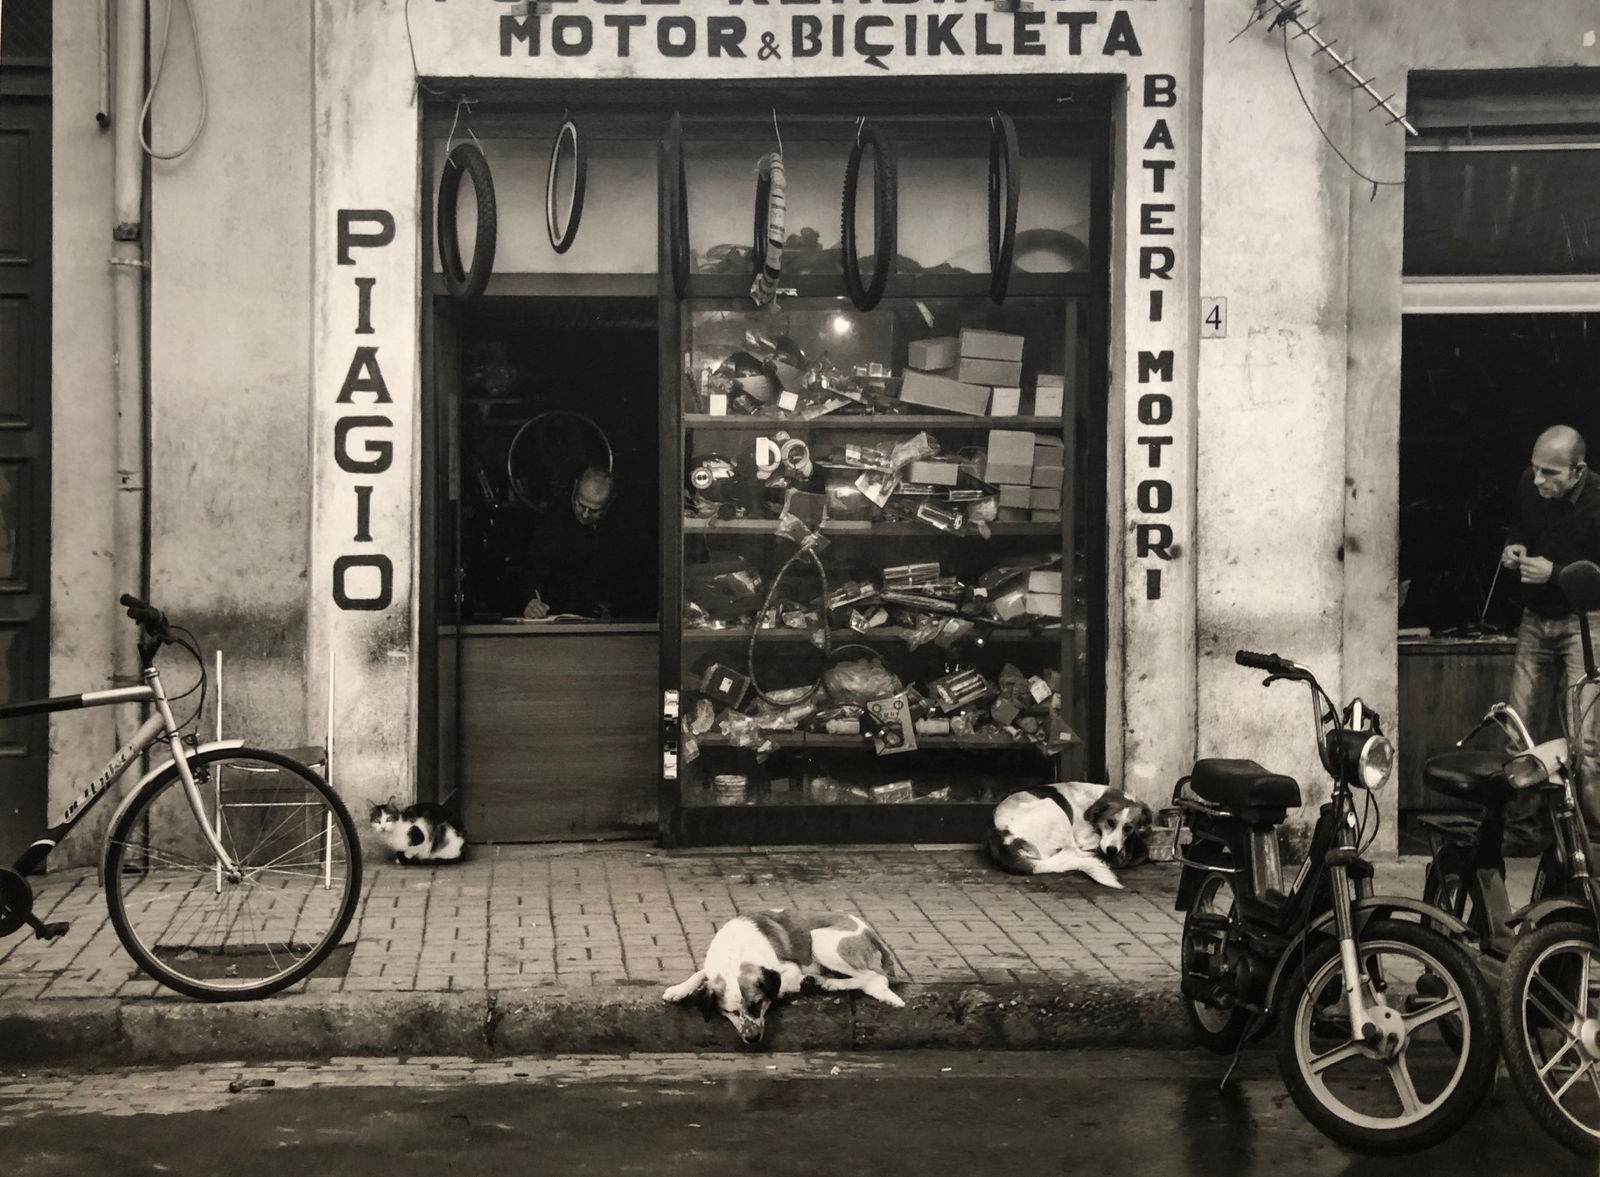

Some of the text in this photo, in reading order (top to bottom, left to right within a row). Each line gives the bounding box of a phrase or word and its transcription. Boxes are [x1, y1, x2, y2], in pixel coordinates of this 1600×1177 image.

[332, 209, 396, 612] PIAGIO
[1136, 73, 1177, 601] BATERI MOTORI
[1205, 304, 1222, 330] 4
